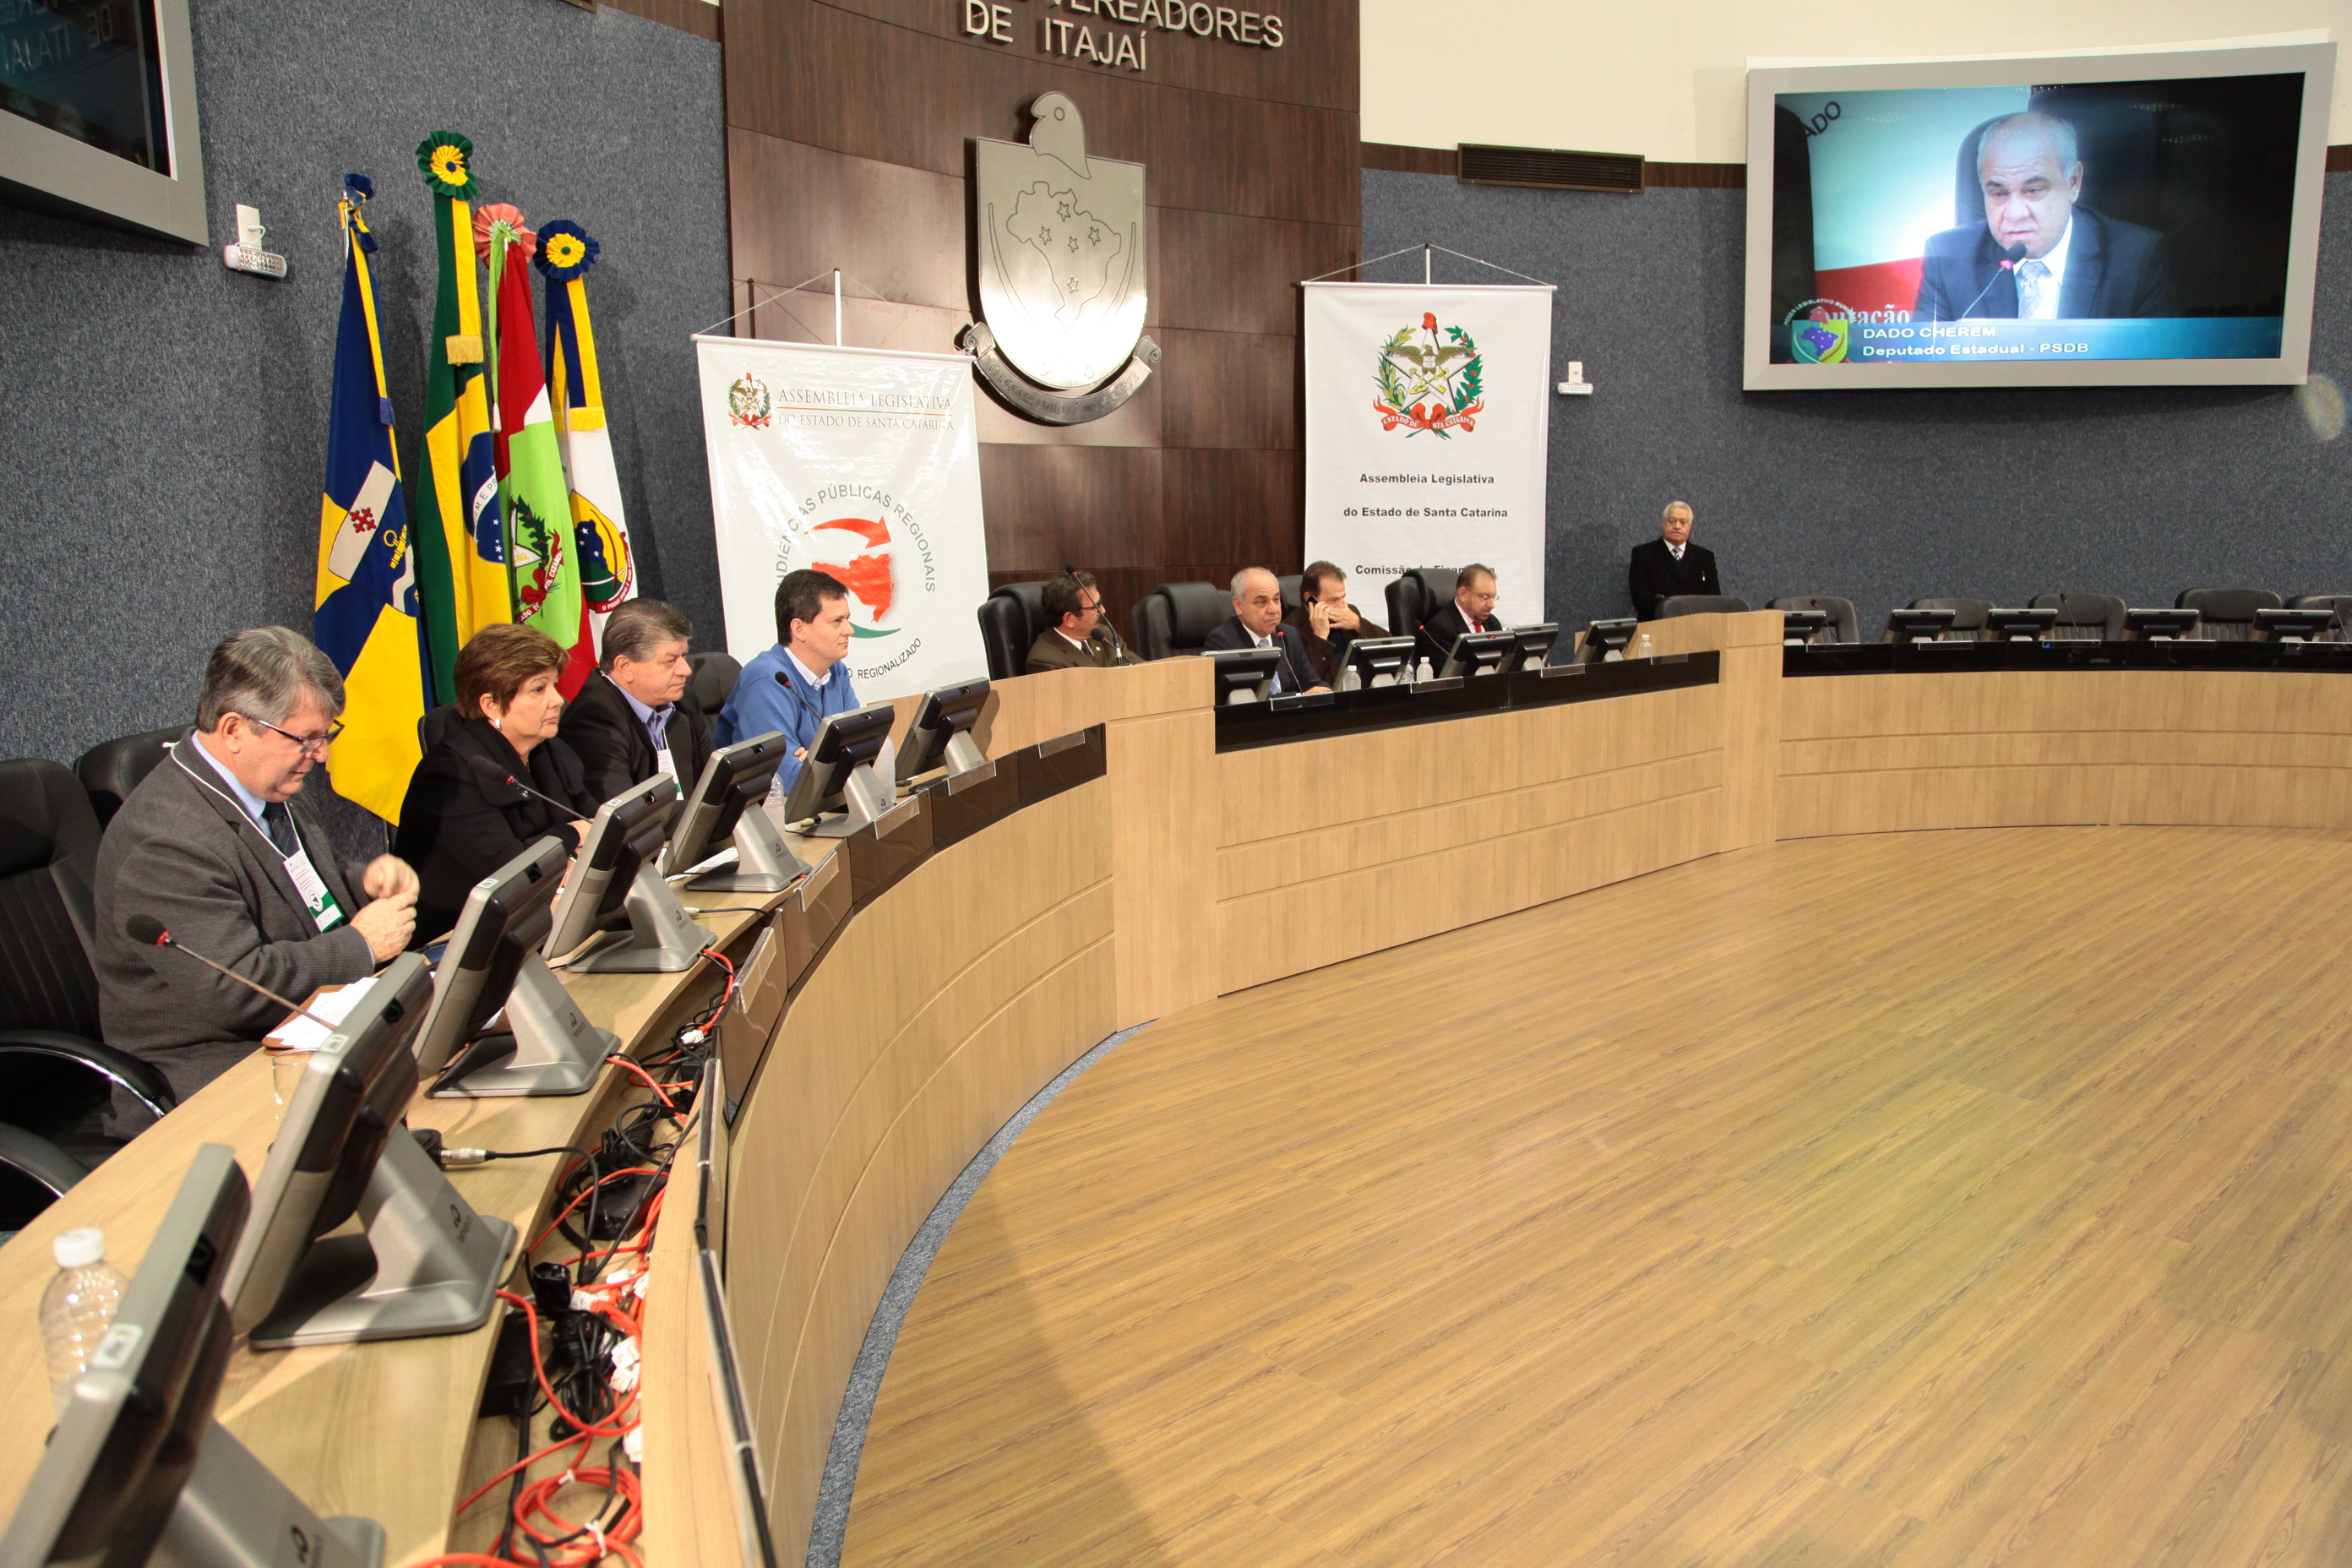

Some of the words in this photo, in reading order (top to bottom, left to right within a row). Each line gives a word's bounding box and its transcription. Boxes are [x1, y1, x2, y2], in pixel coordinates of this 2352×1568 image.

[966, 0, 1013, 42] DE
[1044, 17, 1146, 70] ITAJAÍ
[1863, 328, 1914, 340] DADO
[1919, 327, 1997, 338] CHEREM
[1863, 346, 1946, 357] Deputado
[1950, 344, 2025, 355] Estadual
[2039, 343, 2089, 353] PSDB
[778, 389, 865, 406] ASSEMBLEIA
[871, 393, 952, 411] LEGISLATIVA
[778, 413, 797, 425] DO
[800, 415, 844, 427] ESTADO
[848, 416, 862, 427] DE
[866, 417, 900, 429] SANTA
[902, 418, 954, 432] CATARIA
[1359, 473, 1428, 483] Assembleia
[1431, 474, 1494, 486] Legislativa
[1343, 507, 1358, 517] do
[1362, 507, 1402, 517] Estado
[1406, 507, 1420, 517] de
[1424, 508, 1456, 517] Santa
[1461, 508, 1508, 517] Catarina
[818, 483, 892, 508] PÚBLICAS
[893, 503, 936, 592] REGIONAIS
[858, 637, 922, 679] REGIONALIZADO
